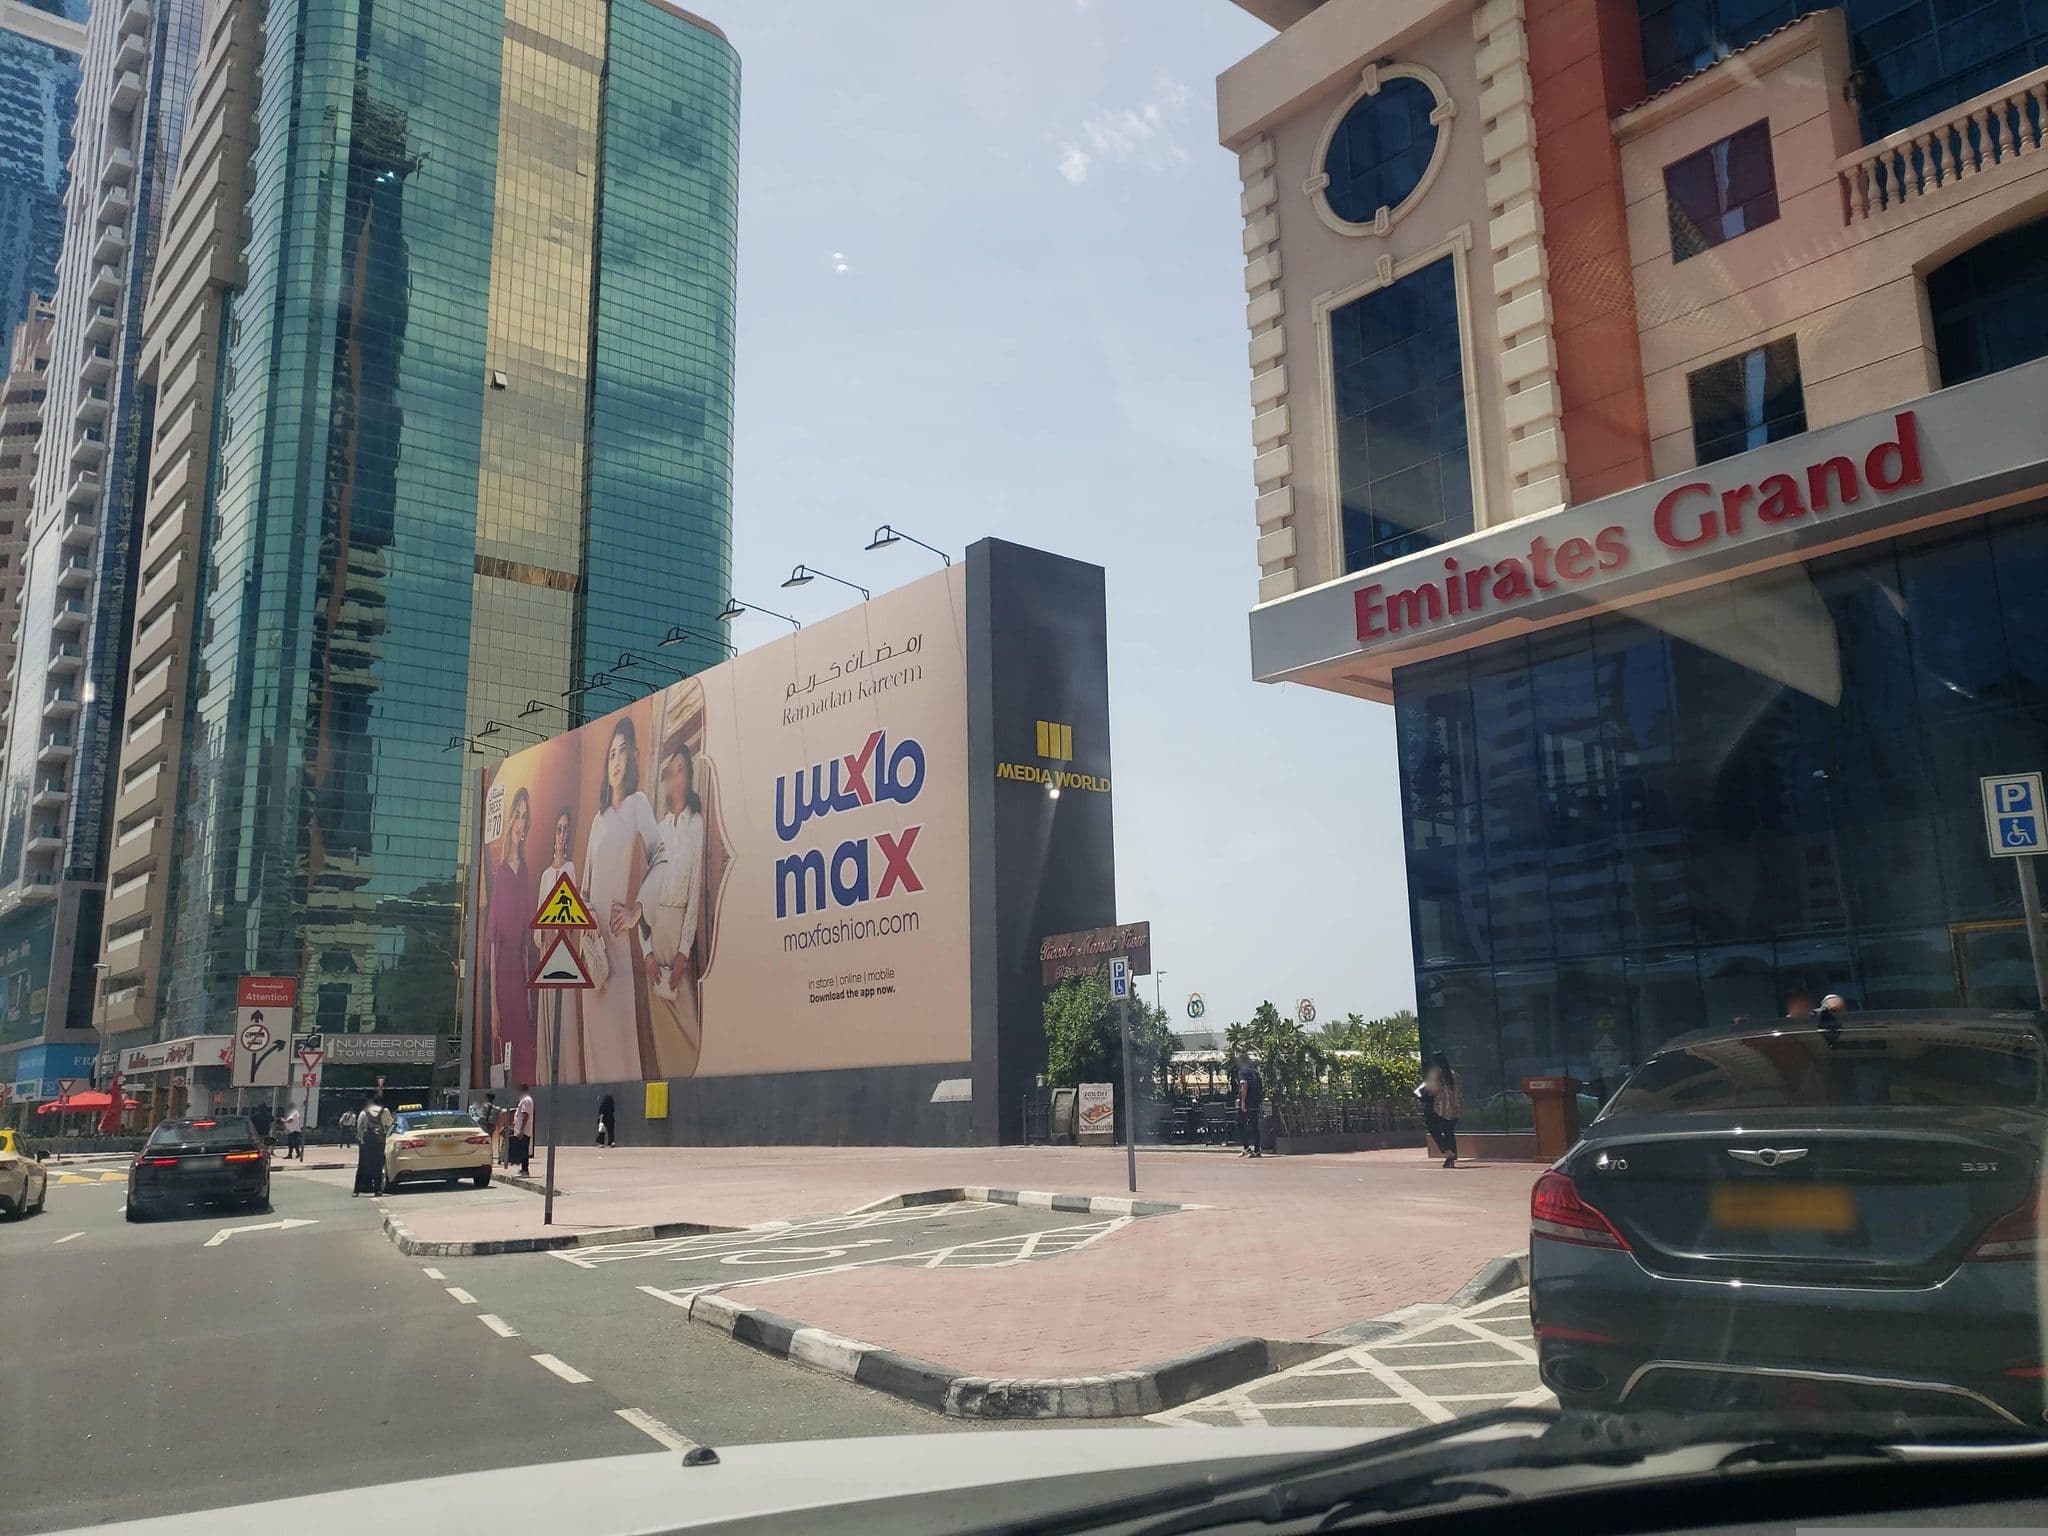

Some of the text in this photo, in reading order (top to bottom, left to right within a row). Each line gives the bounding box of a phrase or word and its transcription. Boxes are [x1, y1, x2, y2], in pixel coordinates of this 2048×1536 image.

[1353, 410, 1924, 642] Emirates Grand
[784, 633, 924, 702] رمضان كريم
[783, 664, 923, 727] Ramadan Kareem
[996, 762, 1111, 793] MEDIA WORLD
[2001, 784, 2027, 812] P
[775, 825, 924, 919] max
[783, 911, 920, 953] maxfashion.com
[808, 968, 895, 990] in store online mobile
[1115, 962, 1125, 977] P
[245, 992, 289, 1001] Attention
[809, 984, 896, 1004] Download the app now.
[336, 1039, 401, 1049] NUMBER
[403, 1039, 435, 1048] ONE
